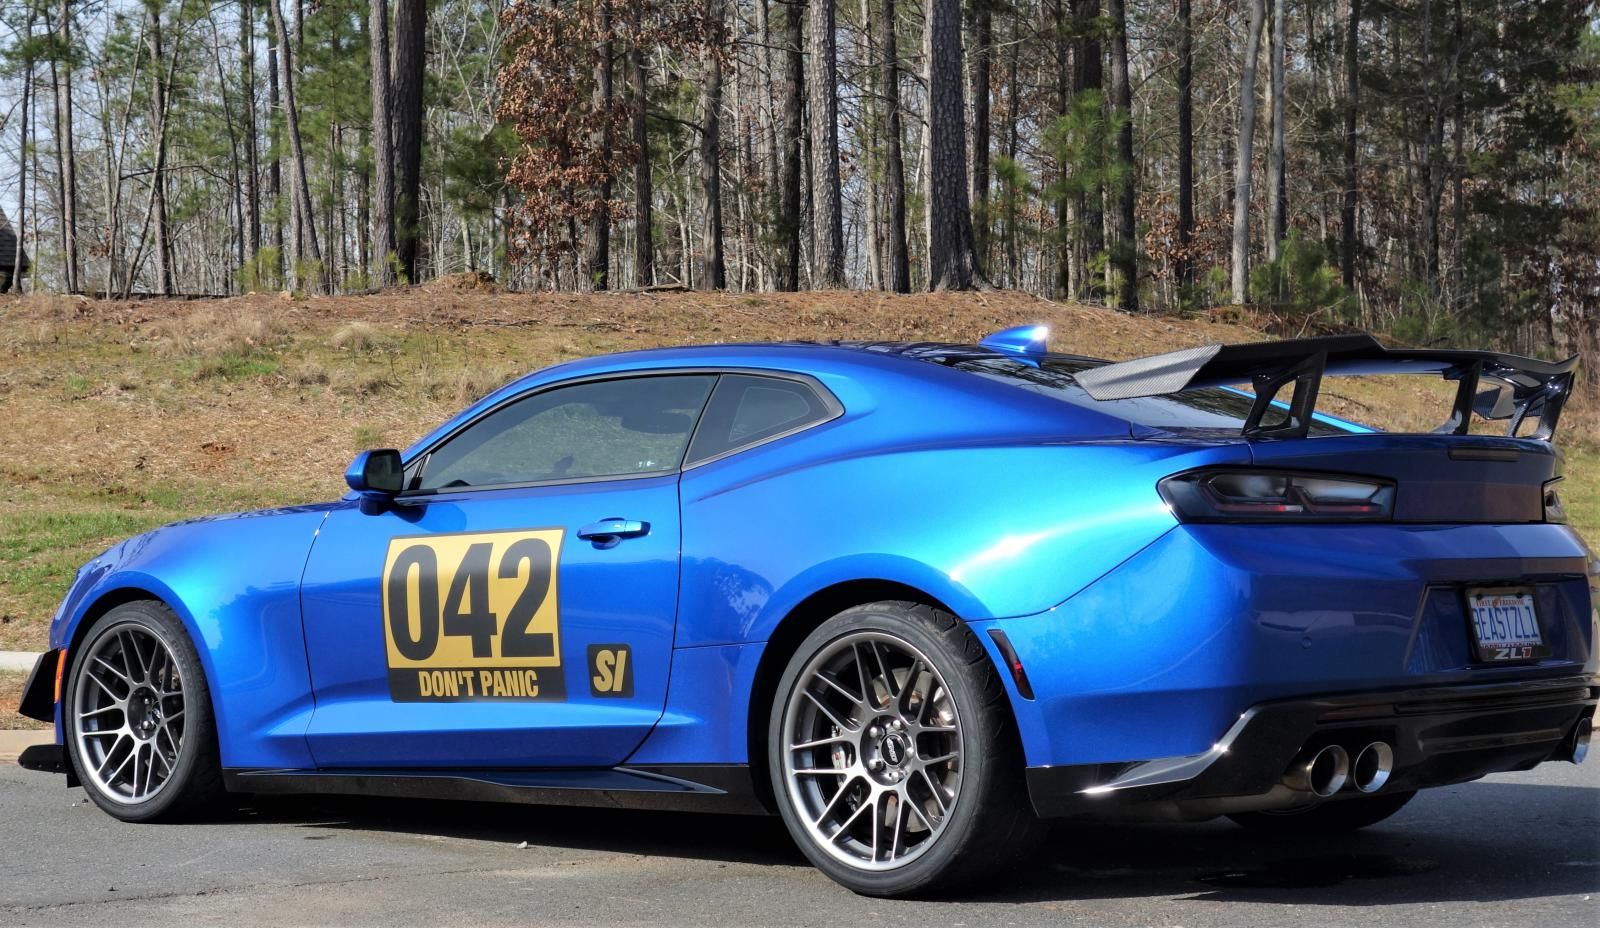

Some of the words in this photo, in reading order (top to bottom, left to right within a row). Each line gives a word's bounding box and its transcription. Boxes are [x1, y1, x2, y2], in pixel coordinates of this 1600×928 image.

[388, 538, 554, 661] 042
[1472, 606, 1538, 640] BEASTZL1
[1494, 646, 1532, 660] ZL1
[418, 670, 474, 697] DON'T
[480, 670, 539, 698] PANIC
